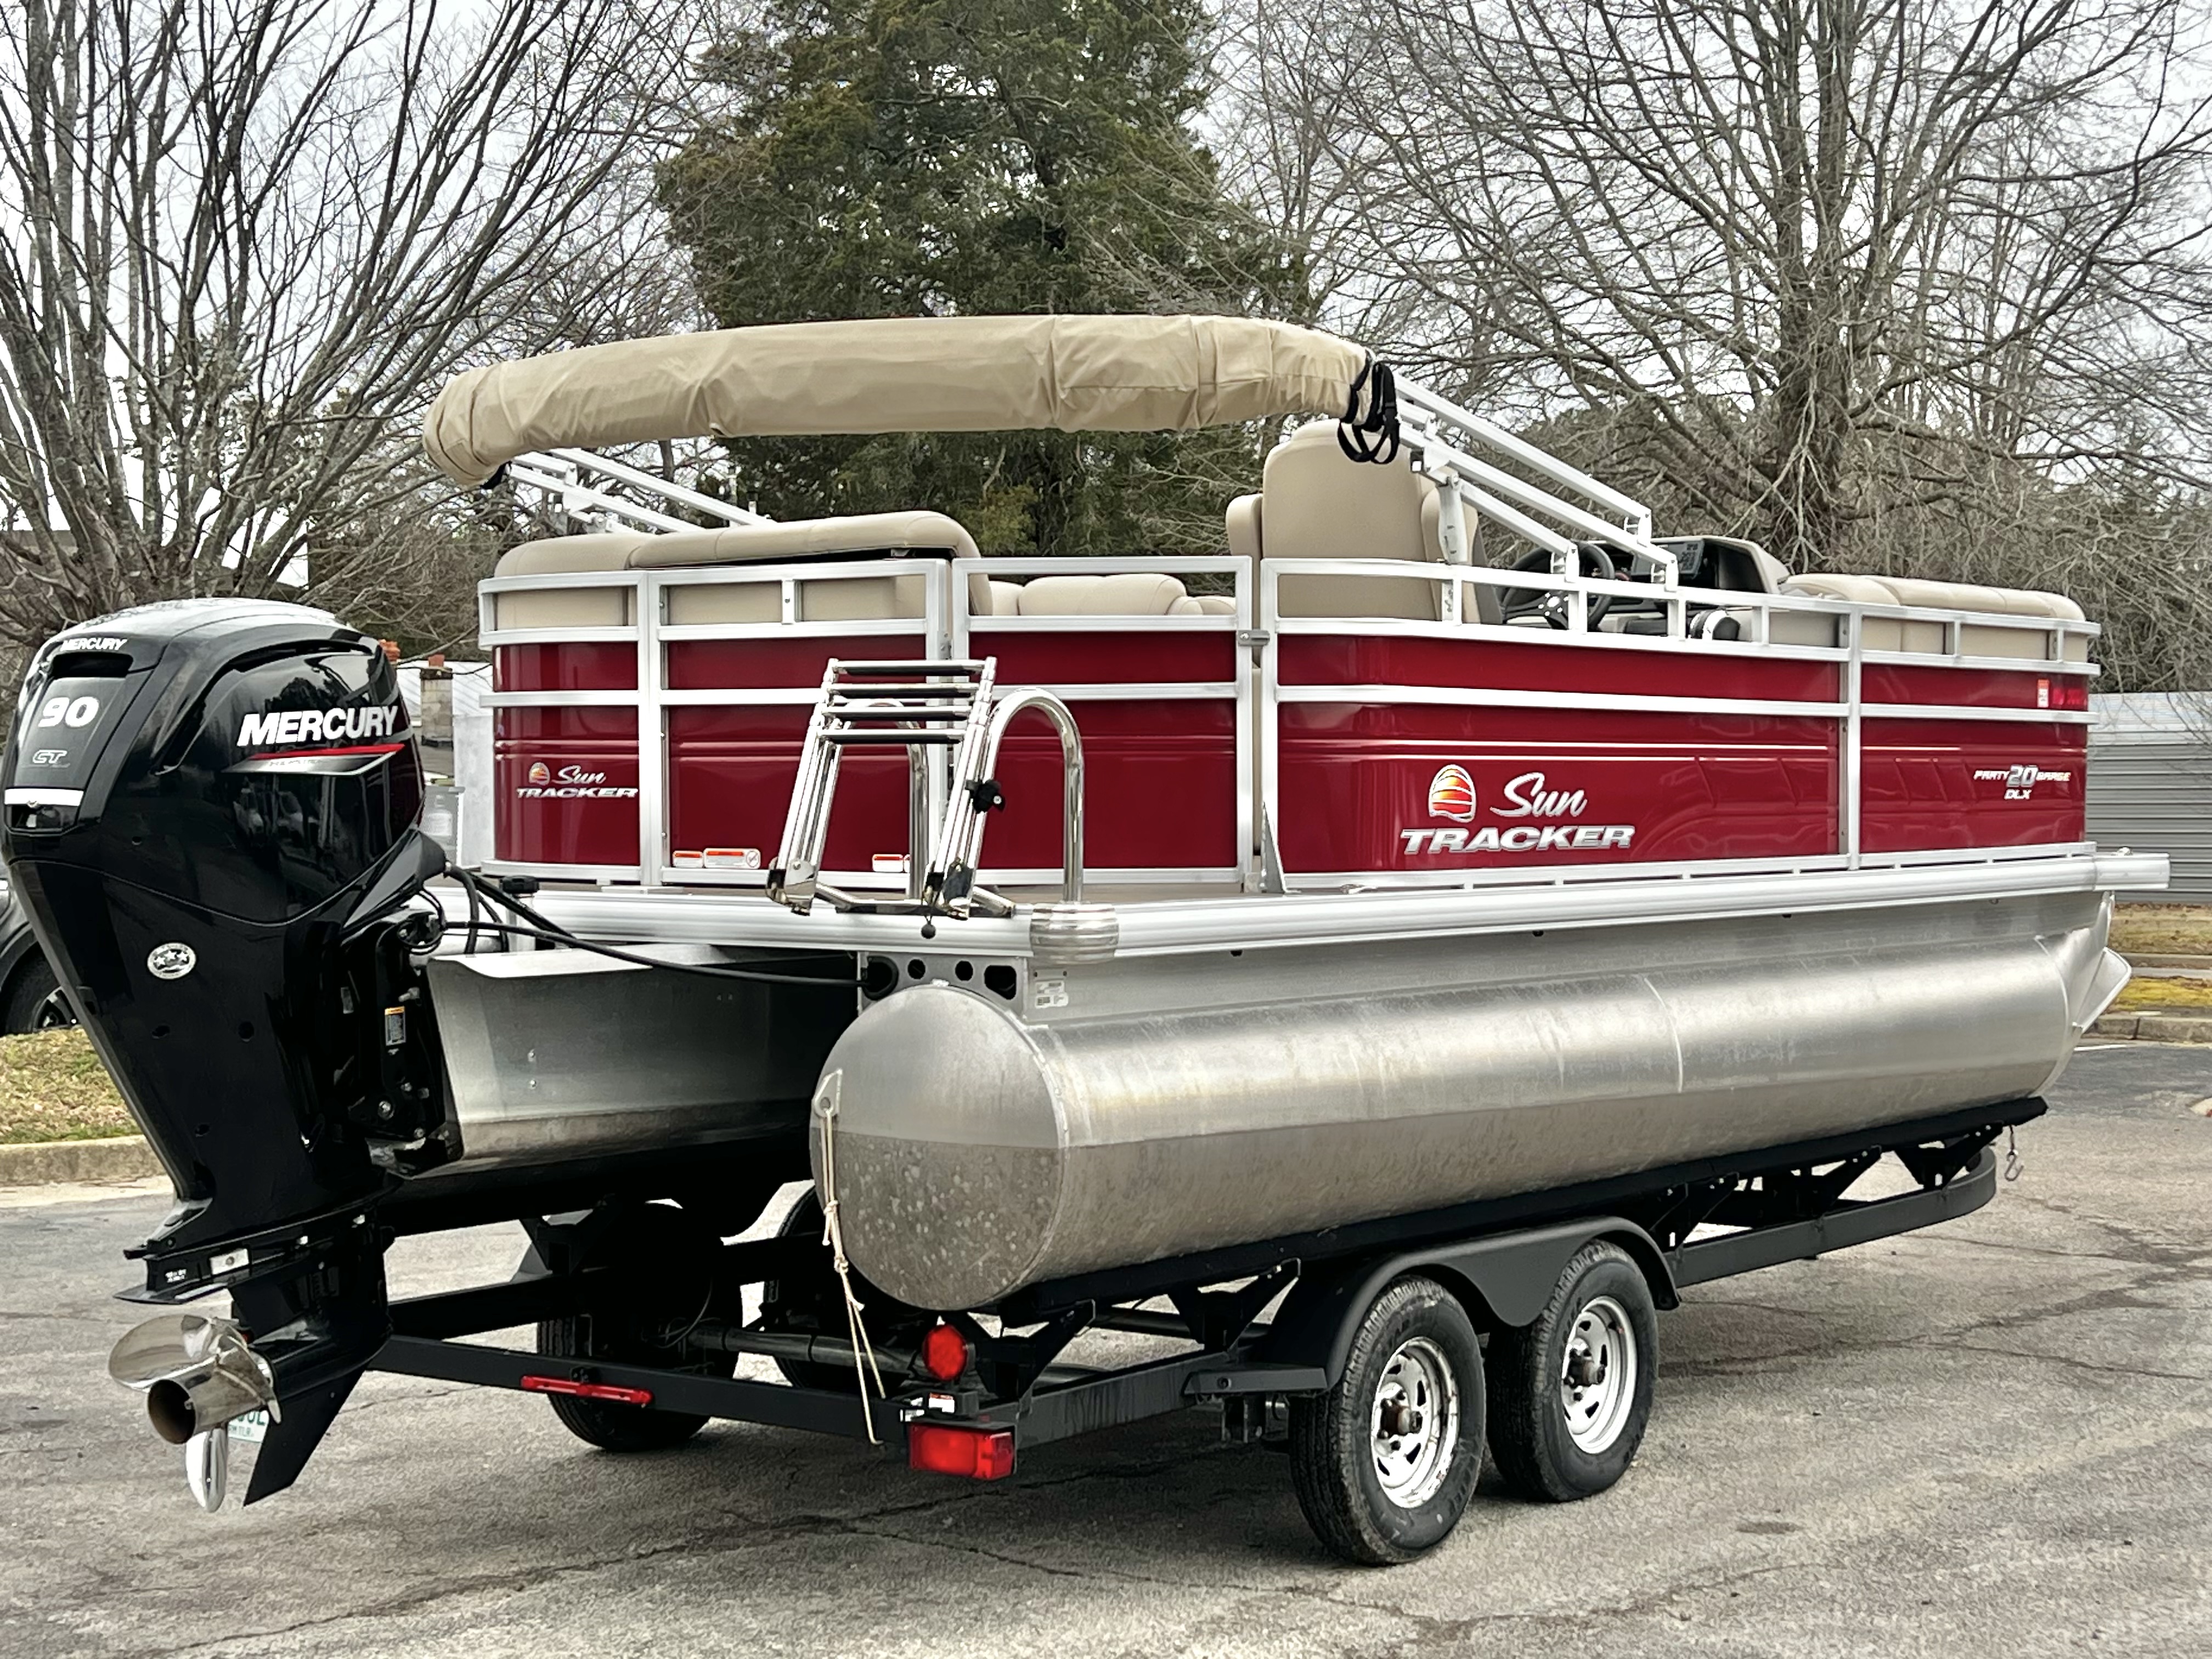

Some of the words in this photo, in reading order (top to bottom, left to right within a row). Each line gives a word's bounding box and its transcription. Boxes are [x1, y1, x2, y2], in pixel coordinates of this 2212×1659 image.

[60, 637, 128, 652] MERCURY
[38, 696, 99, 728] 90
[236, 706, 398, 747] MERCURY
[32, 749, 67, 764] GT
[551, 765, 606, 785] Sun
[1973, 770, 2010, 780] PARTY
[2006, 764, 2039, 787] 20
[2036, 772, 2071, 781] BARGE
[516, 787, 639, 799] TRACKER
[1489, 772, 1588, 817] Sun
[2004, 789, 2032, 799] DLX
[1400, 825, 1635, 855] TRACKER
